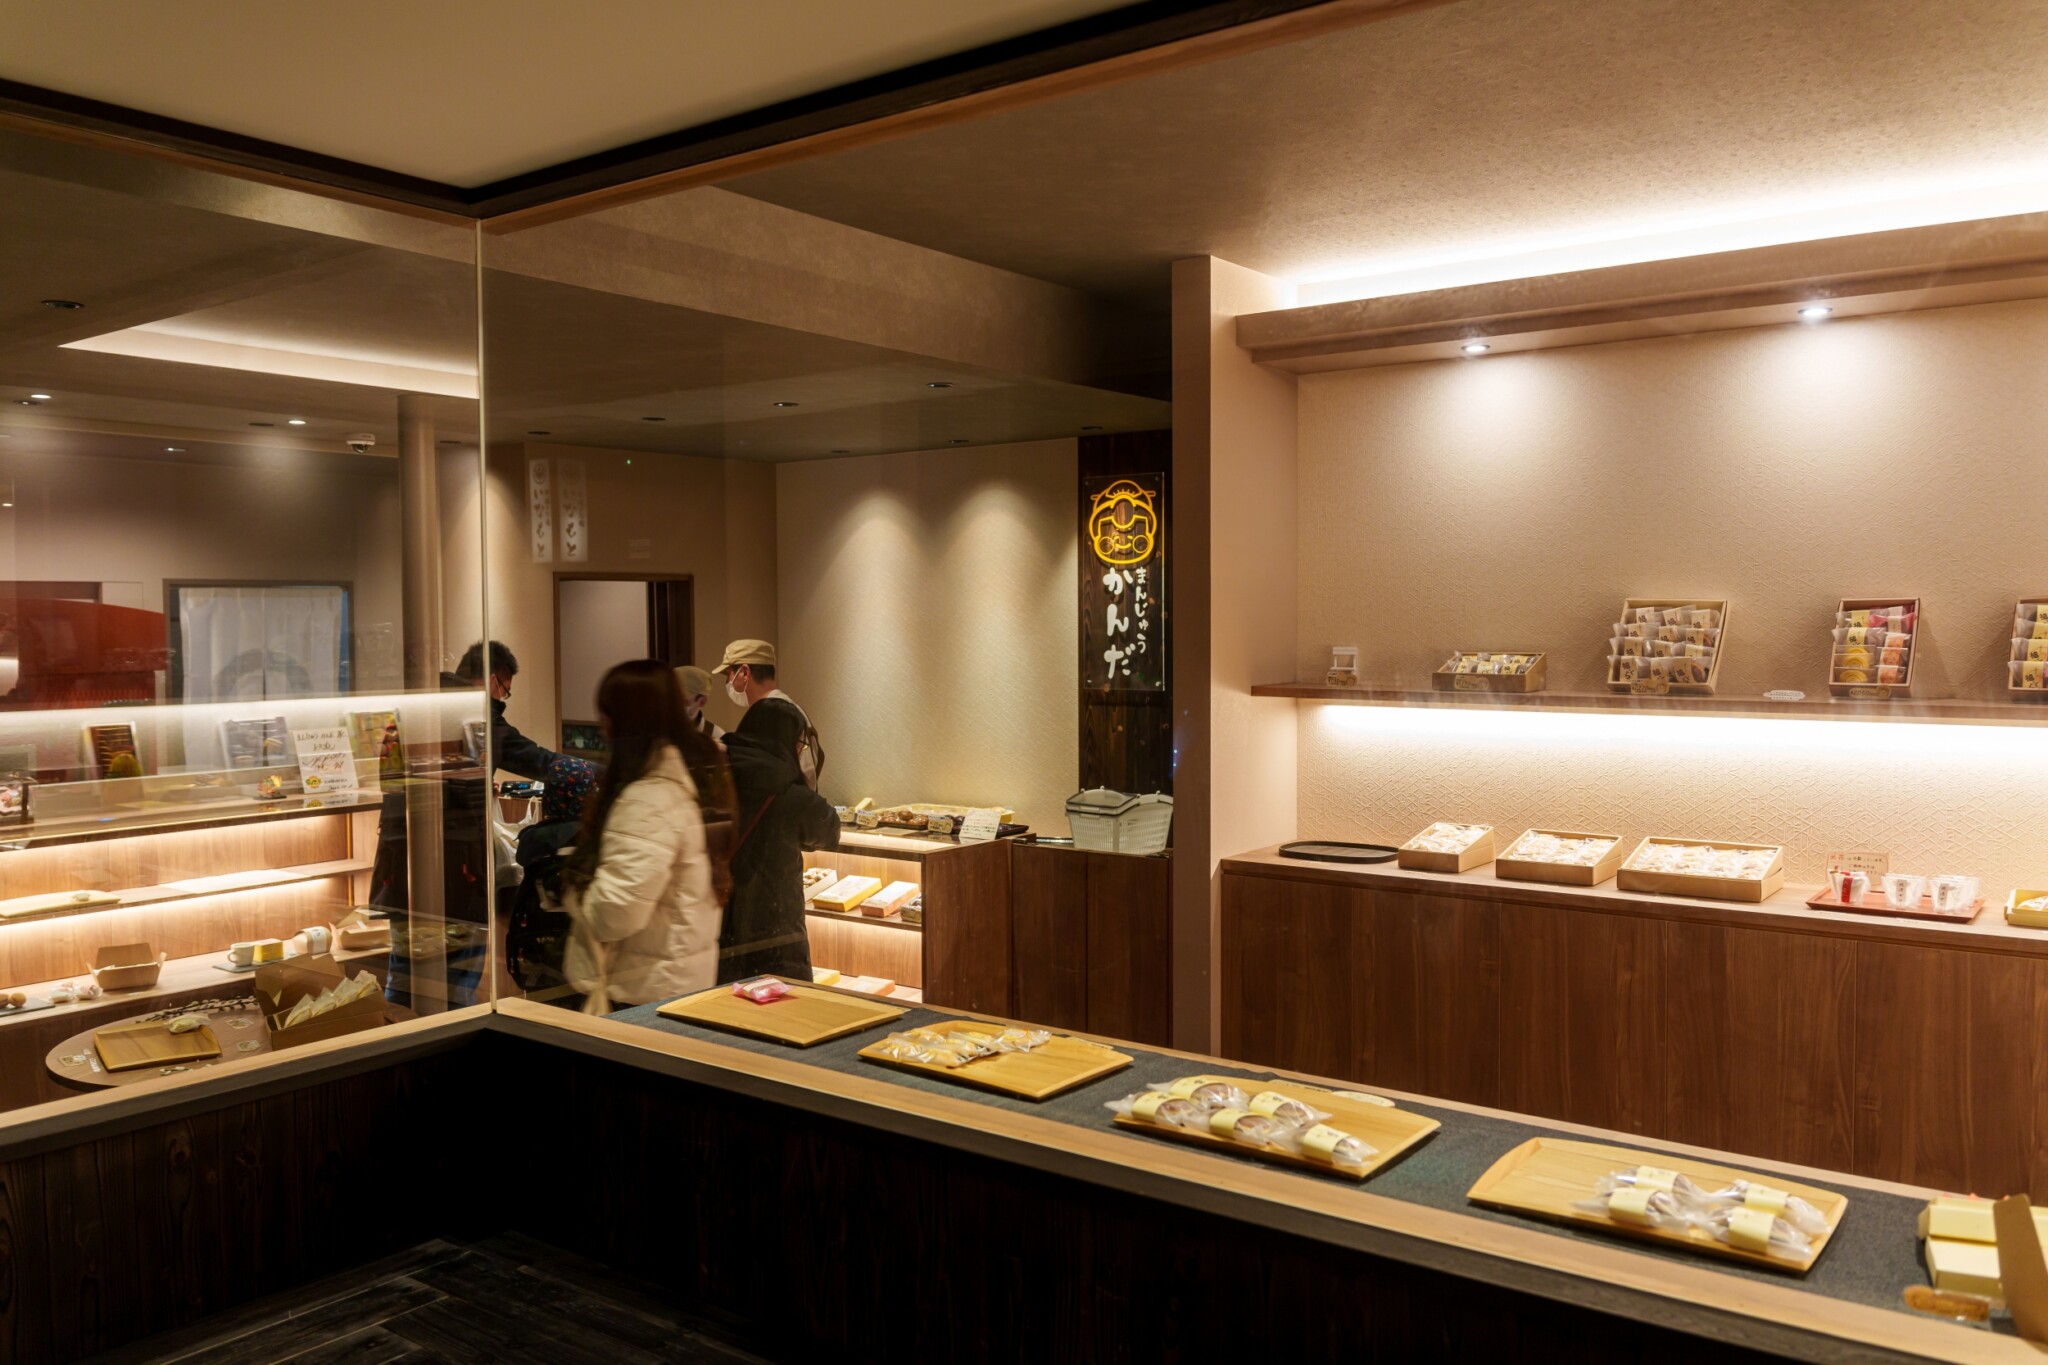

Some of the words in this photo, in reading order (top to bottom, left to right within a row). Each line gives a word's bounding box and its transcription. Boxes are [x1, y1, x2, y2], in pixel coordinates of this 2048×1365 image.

[1102, 567, 1136, 679] かんだ
[1134, 566, 1149, 654] まんじゅう
